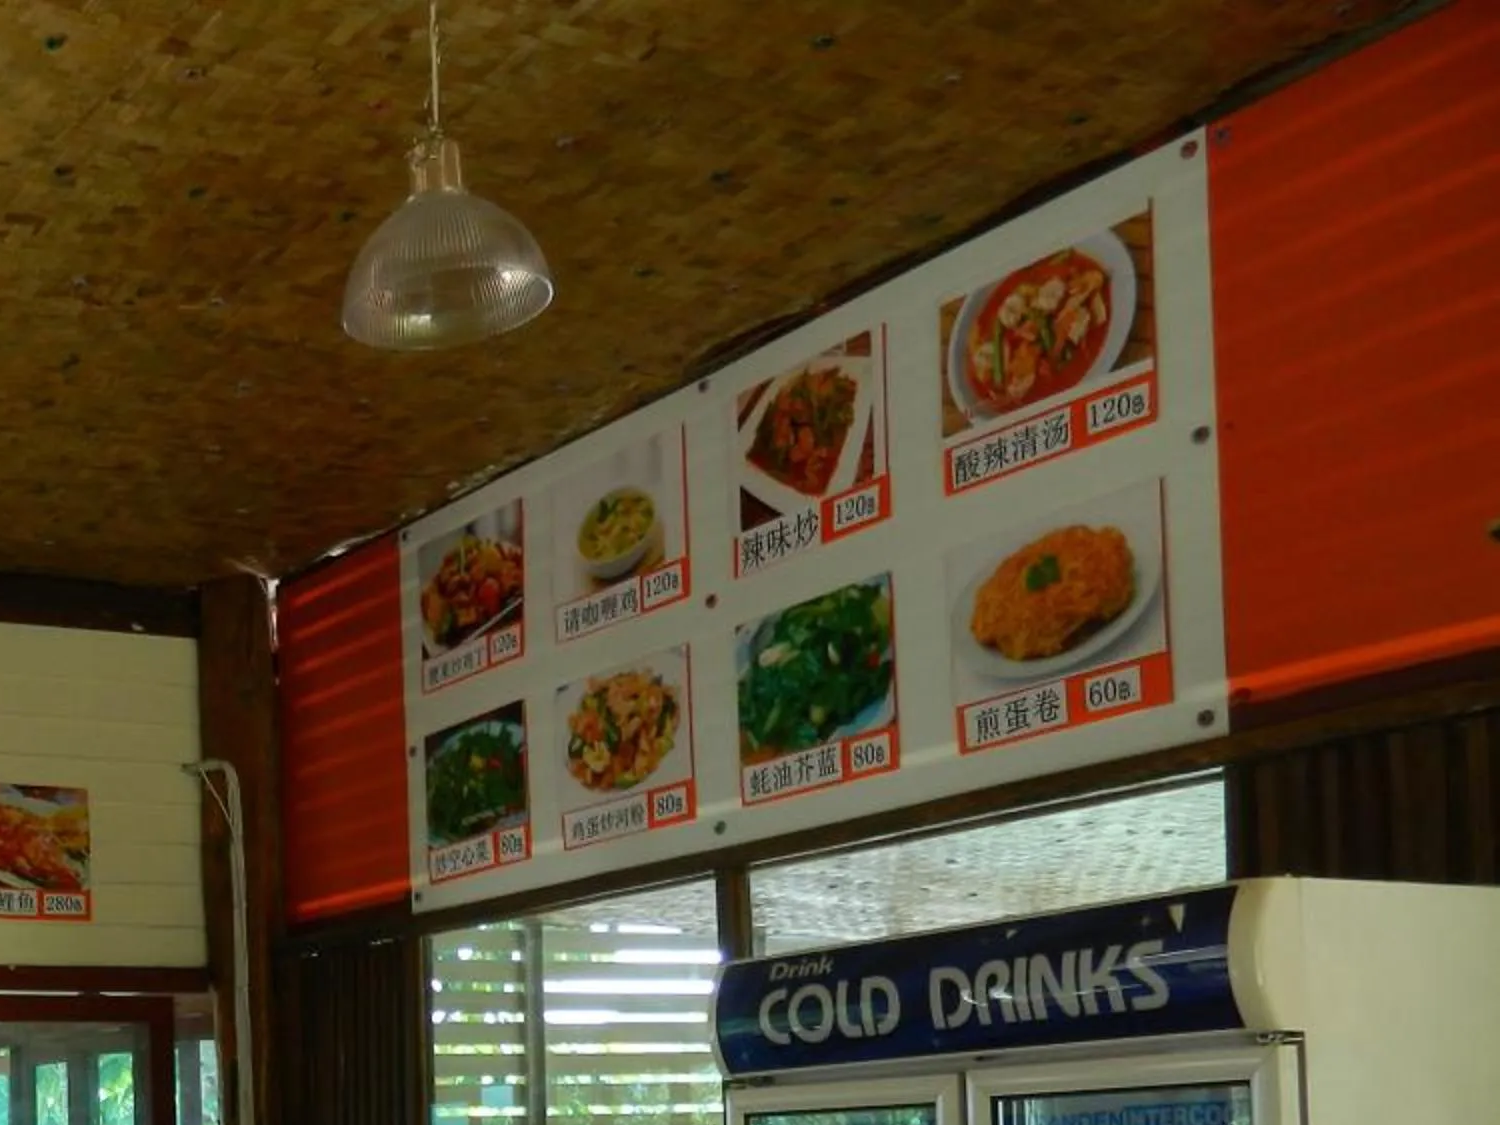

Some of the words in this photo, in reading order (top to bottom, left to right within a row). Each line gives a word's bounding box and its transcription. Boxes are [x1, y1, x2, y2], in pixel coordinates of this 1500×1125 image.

[954, 414, 1070, 485] 酸辣清汤
[741, 507, 819, 573] 辣味炒
[974, 688, 1061, 743] 煎蛋卷
[758, 975, 900, 1046] COLD
[928, 940, 1171, 1031] DRINKS
[770, 956, 834, 981] Drink
